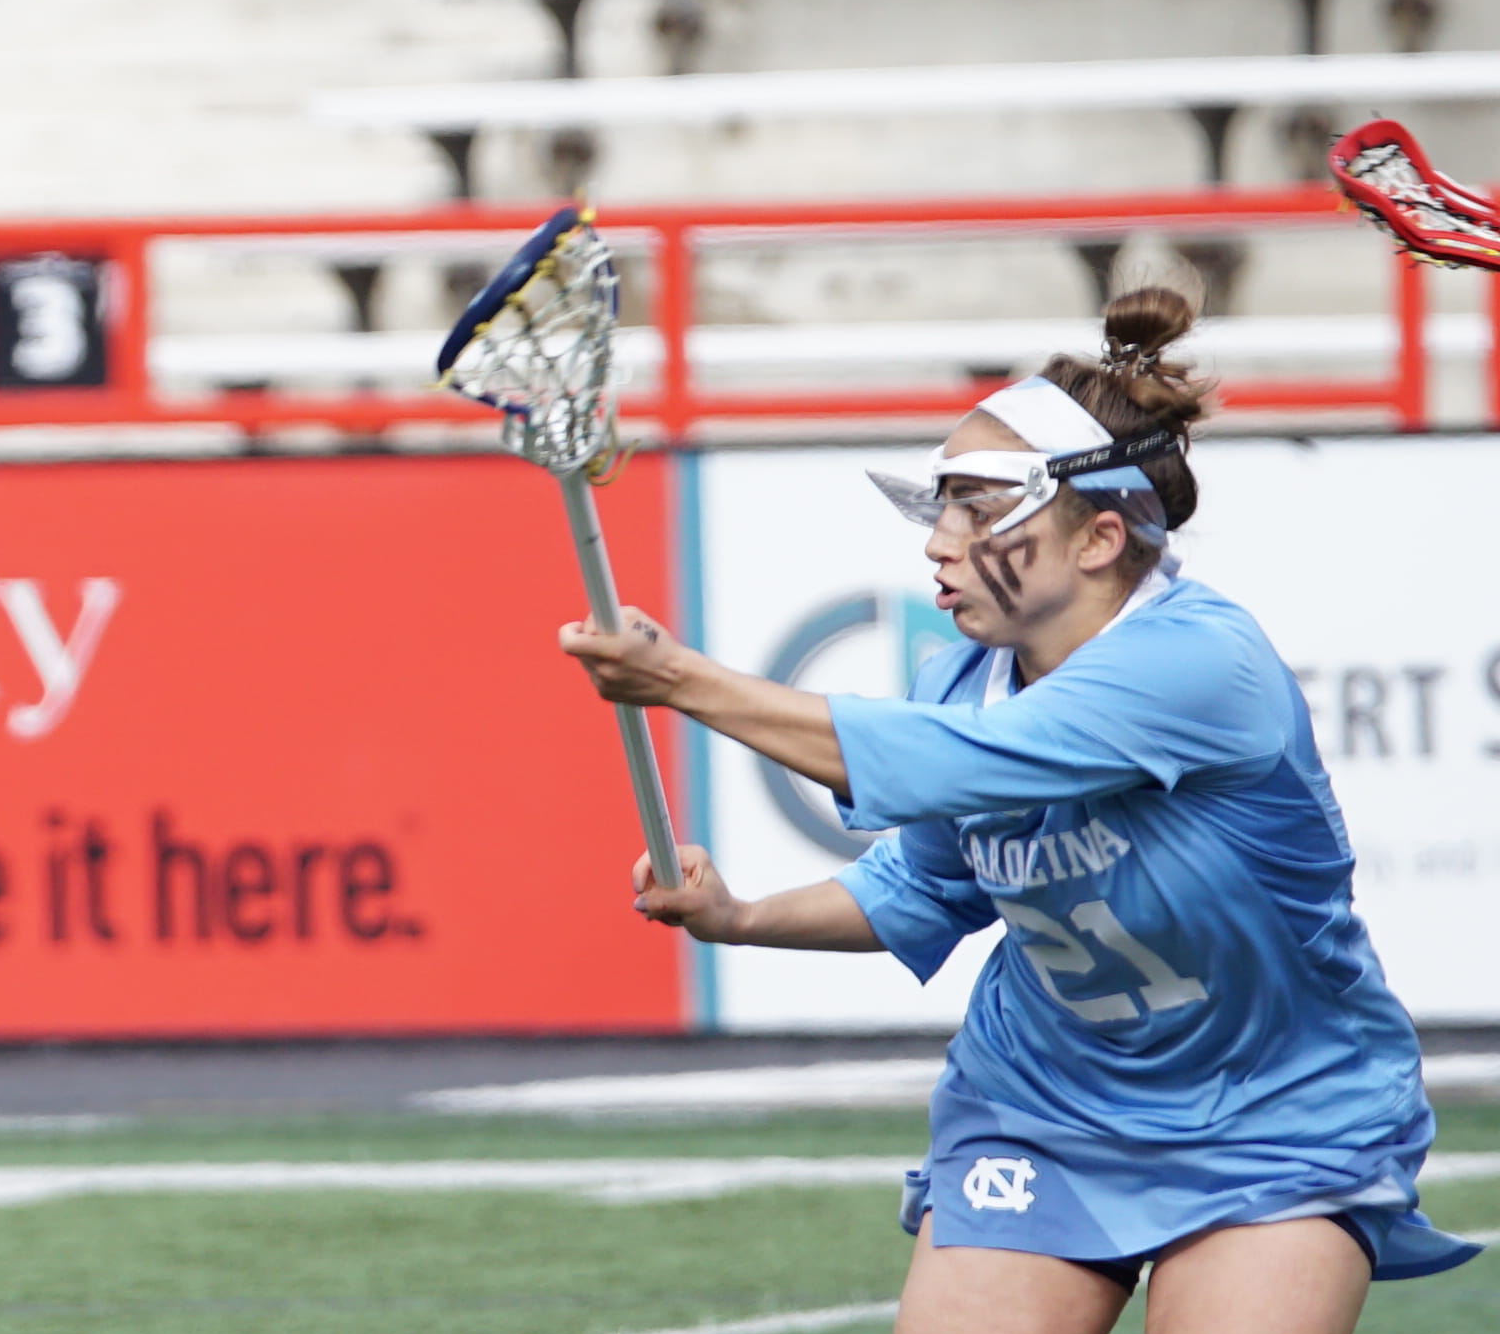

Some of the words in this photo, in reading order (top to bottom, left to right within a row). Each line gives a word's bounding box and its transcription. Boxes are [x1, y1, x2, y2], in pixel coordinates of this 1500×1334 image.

[10, 275, 88, 381] 3
[43, 808, 116, 943] it
[151, 808, 426, 944] here.
[964, 817, 1132, 889] AROLINA
[995, 899, 1209, 1023] 21
